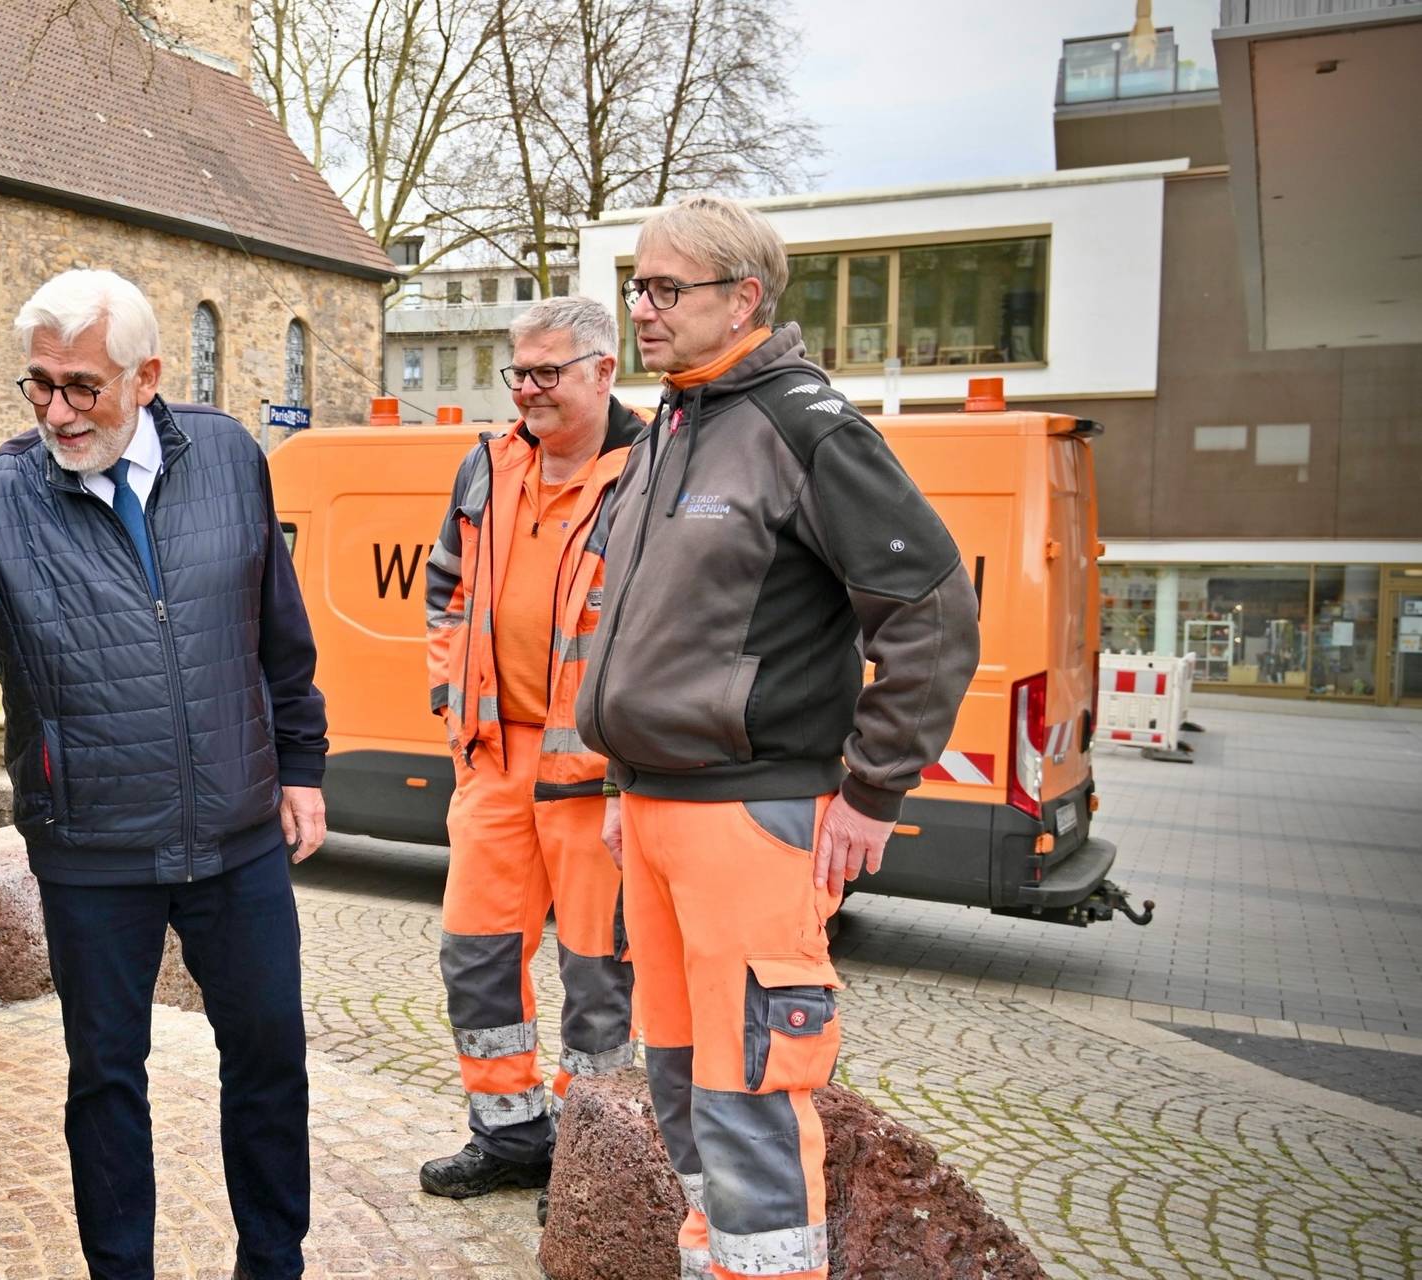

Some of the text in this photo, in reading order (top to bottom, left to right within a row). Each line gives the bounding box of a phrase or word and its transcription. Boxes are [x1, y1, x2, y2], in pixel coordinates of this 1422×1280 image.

[271, 408, 308, 424] Paris Str.
[690, 495, 720, 503] STADT
